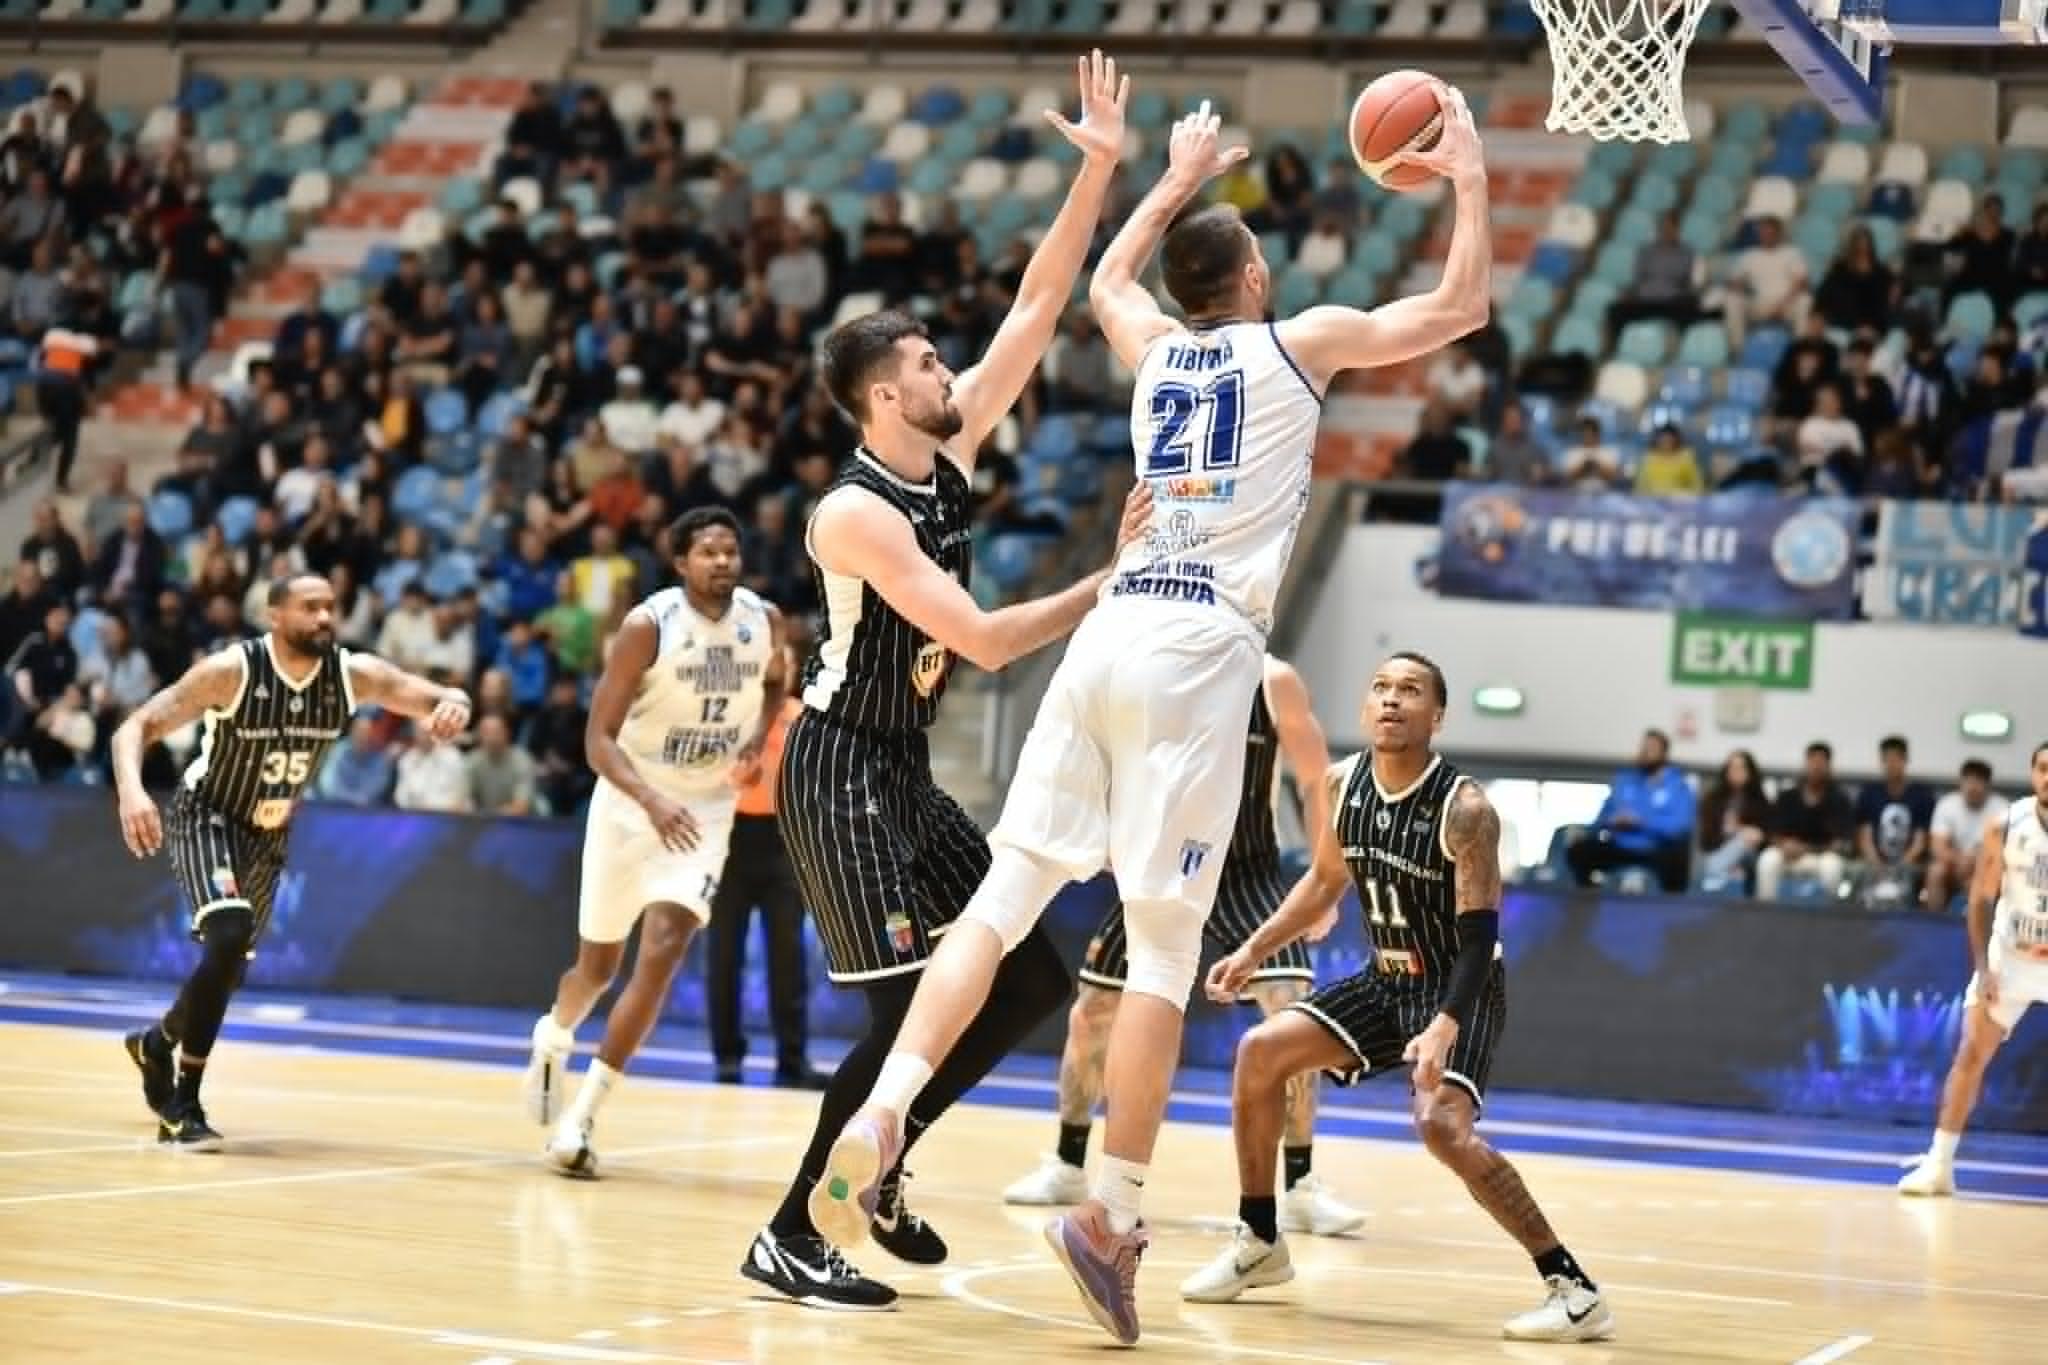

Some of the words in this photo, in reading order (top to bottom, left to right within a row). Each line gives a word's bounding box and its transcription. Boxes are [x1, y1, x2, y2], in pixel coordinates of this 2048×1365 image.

[1144, 368, 1243, 477] 21
[1680, 525, 1738, 562] LEI
[1681, 629, 1805, 676] EXIT
[701, 697, 729, 722] 12
[263, 751, 311, 784] 35
[1366, 878, 1408, 926] 11
